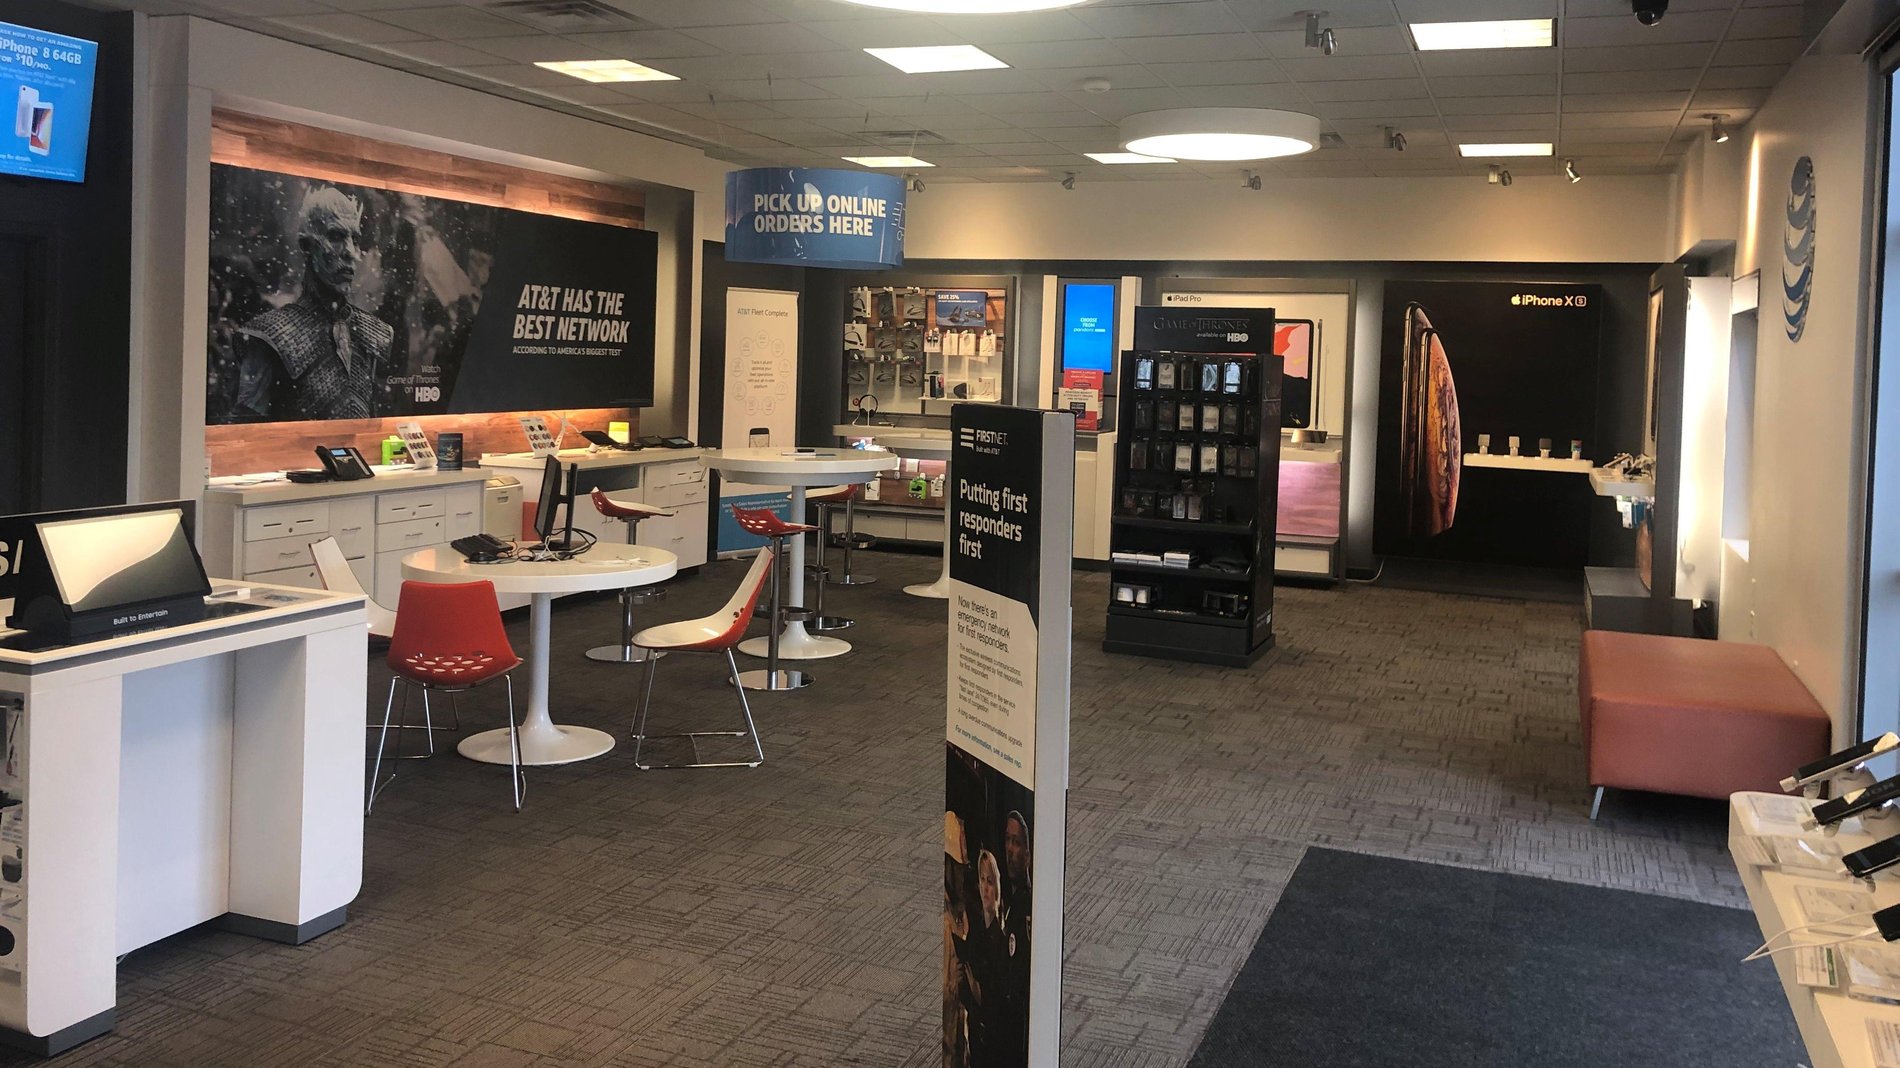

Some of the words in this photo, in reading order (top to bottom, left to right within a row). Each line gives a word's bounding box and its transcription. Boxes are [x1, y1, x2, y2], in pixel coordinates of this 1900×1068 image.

[0, 36, 38, 56] iPhone
[42, 46, 50, 58] 8
[52, 48, 82, 64] 64GB
[754, 193, 792, 212] PICK
[797, 194, 823, 212] UP
[827, 195, 886, 218] ONLINE
[754, 214, 824, 234] ORDERS
[829, 216, 874, 236] HERE
[518, 284, 561, 311] AT&T
[562, 288, 593, 313] HAS
[597, 290, 625, 316] THE
[1522, 294, 1563, 306] iPhone
[764, 310, 788, 318] Complete
[1154, 317, 1188, 330] GAME
[1196, 318, 1250, 330] THRONES
[513, 314, 556, 340] BEST
[557, 316, 630, 344] NETWORK
[1226, 332, 1248, 342] HBO
[512, 346, 548, 354] ACCORDING
[548, 346, 556, 354] TO
[557, 347, 586, 356] AMERICA'S
[586, 348, 608, 356] BIGGEST
[421, 364, 440, 373] Watch
[387, 376, 406, 384] Game
[407, 374, 415, 384] of
[416, 374, 440, 384] Thrones
[415, 386, 440, 402] HBO
[976, 429, 1008, 445] FIRSTNET
[960, 478, 1000, 512] Putting
[1002, 486, 1028, 514] first
[960, 510, 1022, 542] responders
[959, 533, 982, 560] first
[958, 595, 970, 610] Now
[972, 600, 989, 617] there's
[990, 610, 998, 620] an
[113, 616, 128, 626] Built
[138, 609, 168, 620] Entertain
[958, 610, 987, 632] emergency
[988, 622, 1010, 639] network
[966, 624, 976, 639] first
[977, 632, 1009, 654] responders.
[962, 730, 970, 739] more
